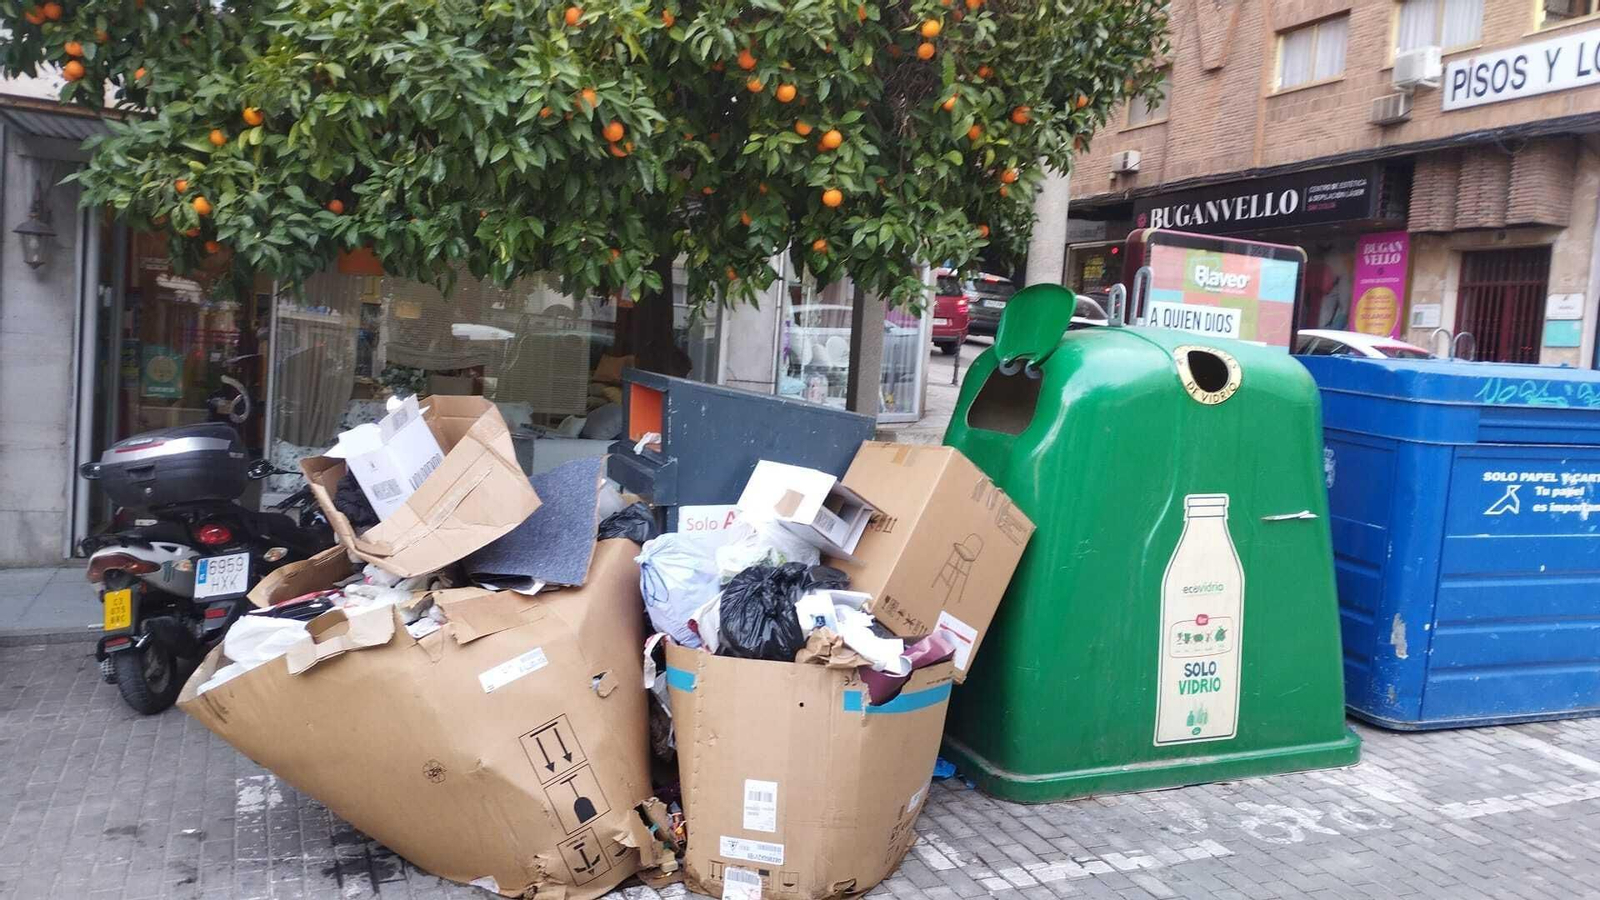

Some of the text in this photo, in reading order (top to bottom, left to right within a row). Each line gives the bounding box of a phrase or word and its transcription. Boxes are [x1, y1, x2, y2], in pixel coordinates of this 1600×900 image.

[1452, 54, 1528, 102] PISOS
[1545, 47, 1562, 83] Y
[1150, 188, 1299, 230] BUGANVELLO
[1363, 241, 1402, 254] BUGAN
[1363, 252, 1401, 266] VELLO
[1150, 307, 1234, 334] A QUIEN DIOS
[1201, 382, 1236, 403] VIDRIO
[1483, 471, 1518, 482] SOLO
[1519, 472, 1558, 483] PAPEL
[1534, 486, 1585, 498] Tu papel
[1532, 504, 1548, 512] es
[686, 516, 718, 532] Solo
[209, 556, 244, 576] 6959
[211, 573, 239, 593] HXK
[1183, 581, 1225, 594] ecovidrio
[1184, 660, 1217, 678] SOLO
[1178, 677, 1221, 695] VIDRIO
